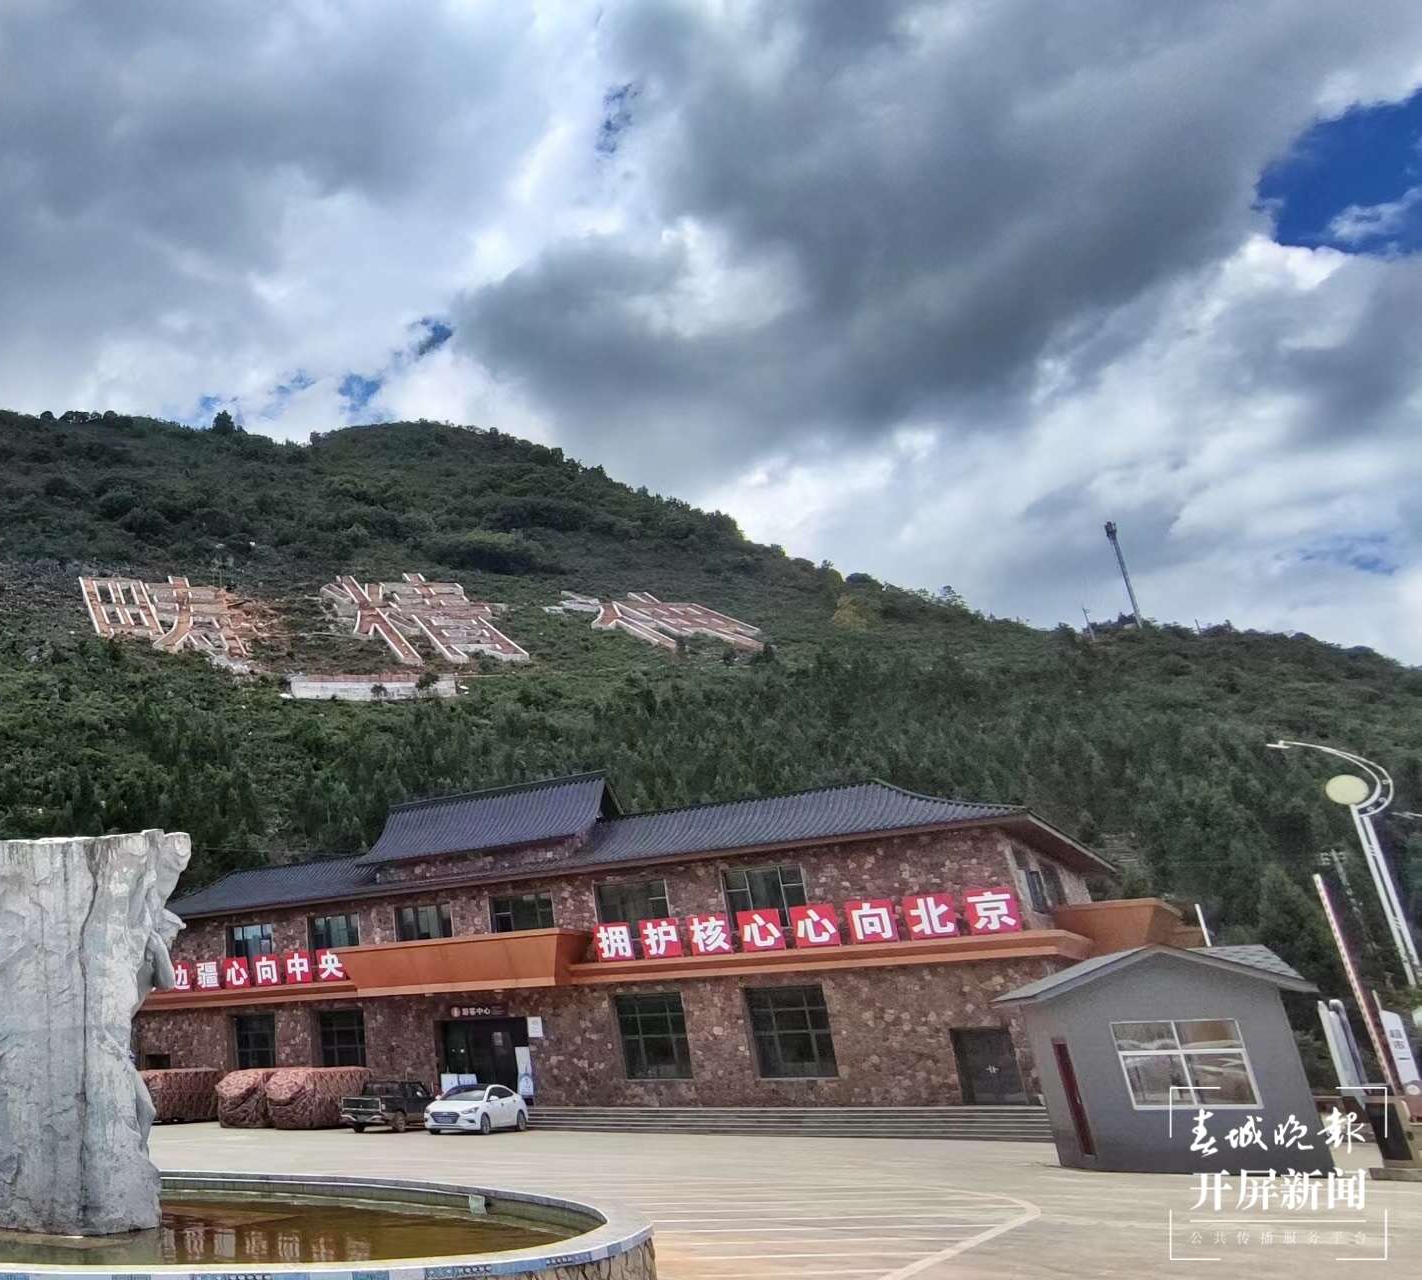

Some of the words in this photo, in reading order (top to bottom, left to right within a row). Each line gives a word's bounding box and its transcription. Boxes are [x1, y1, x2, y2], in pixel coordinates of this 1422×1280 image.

[596, 891, 1017, 959] 拥护核心心向北京
